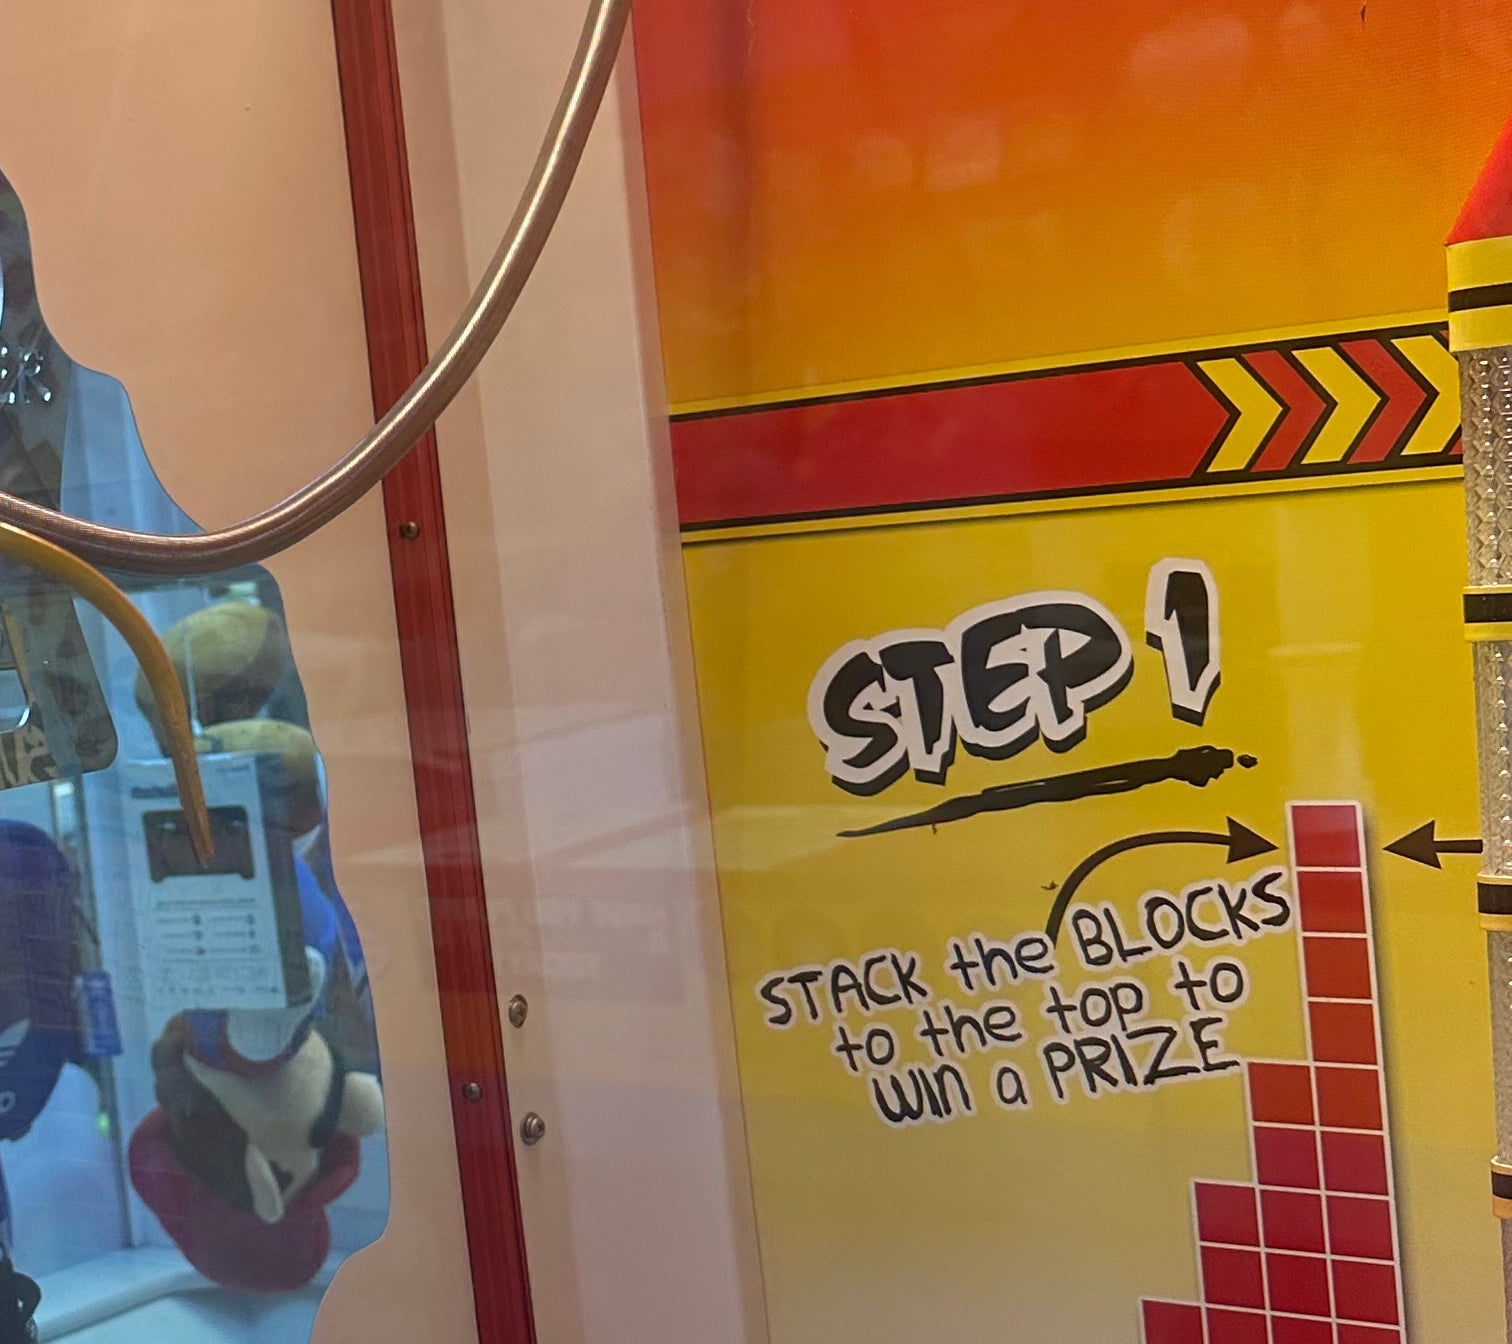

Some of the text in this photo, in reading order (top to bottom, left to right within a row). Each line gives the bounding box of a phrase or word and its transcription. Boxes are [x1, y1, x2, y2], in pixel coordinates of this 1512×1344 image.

[808, 558, 1222, 796] STEP 1
[760, 870, 1291, 1025] STACK the BLOCKS
[836, 960, 1245, 1073] to the top to
[996, 1065, 1028, 1105] a
[1043, 1017, 1241, 1099] PRIZE
